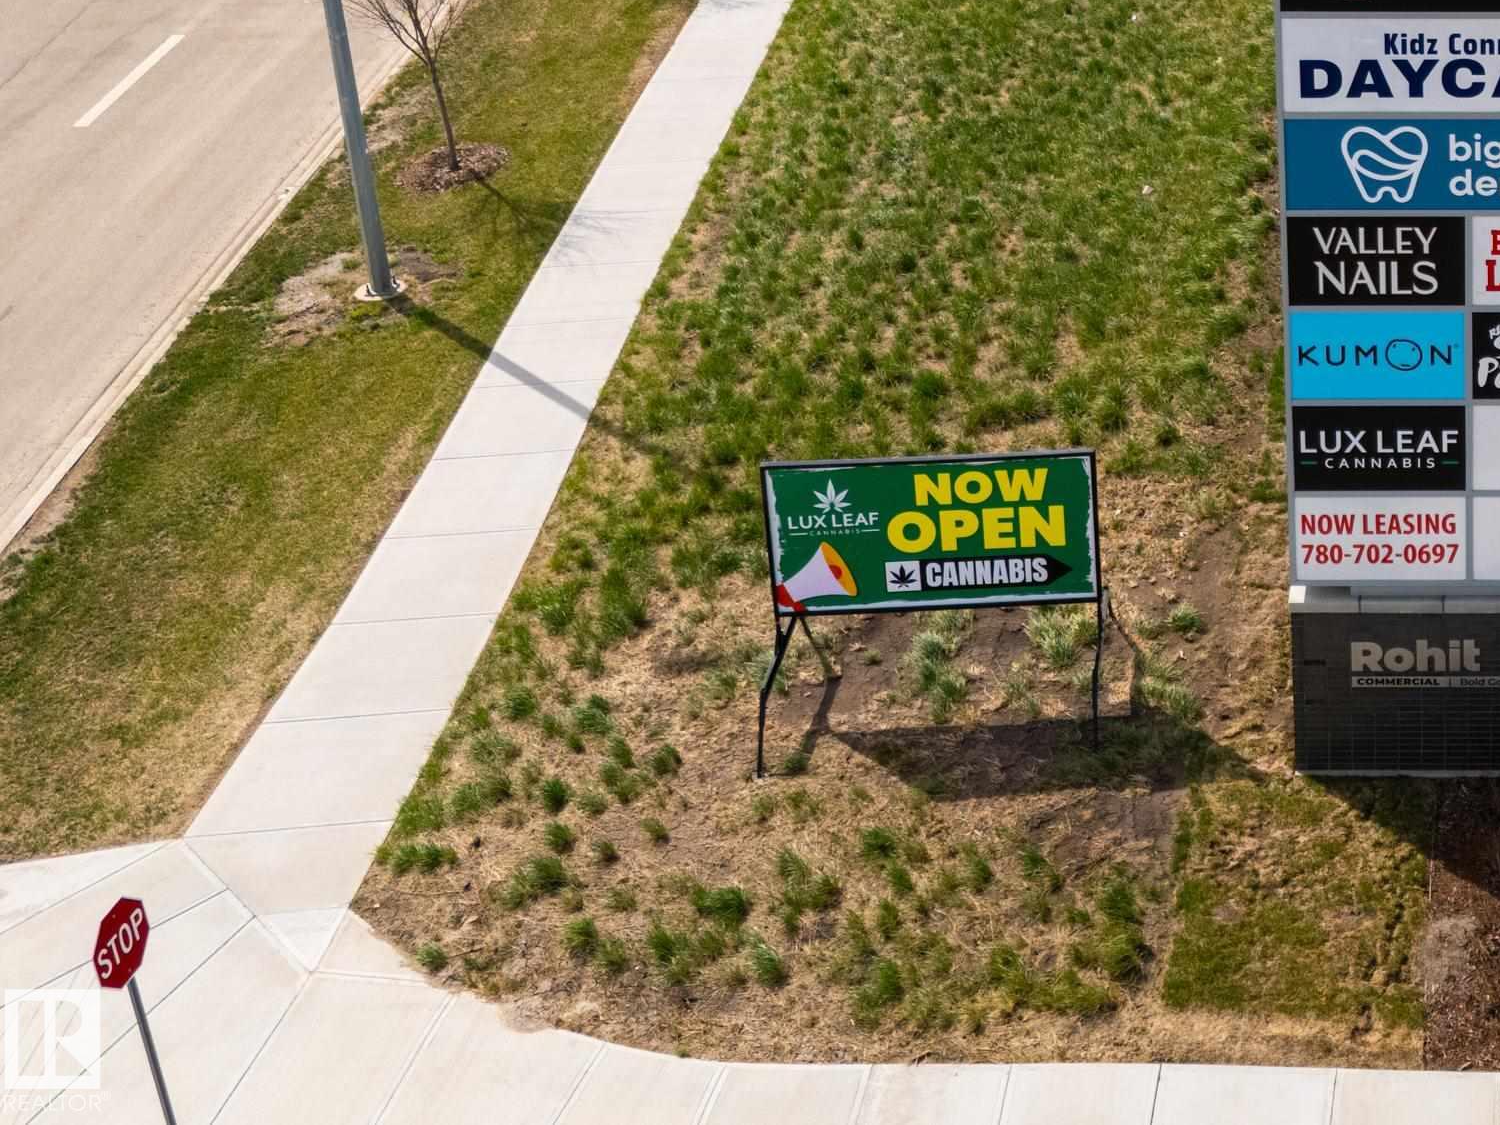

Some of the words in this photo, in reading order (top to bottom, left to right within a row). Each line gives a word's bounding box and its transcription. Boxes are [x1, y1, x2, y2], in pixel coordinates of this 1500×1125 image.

[1384, 33, 1438, 55] Kidz
[1313, 227, 1437, 254] VALLEY
[1315, 260, 1439, 296] NAILS
[1297, 339, 1452, 371] KUMON
[1300, 430, 1366, 454] LUX
[1376, 430, 1458, 453] LEAF
[1324, 457, 1436, 469] CANNABIS
[913, 468, 1049, 507] NOW
[787, 515, 827, 530] LUX
[831, 512, 879, 527] LEAF
[887, 505, 1066, 554] OPEN
[1300, 514, 1355, 535] NOW
[1361, 514, 1457, 535] LEASING
[1300, 543, 1459, 565] 780-702-0697
[925, 558, 1049, 588] CANNABIS
[1350, 639, 1481, 672] Rohit
[1357, 677, 1440, 686] COMMERCIAL
[97, 907, 143, 980] STOP
